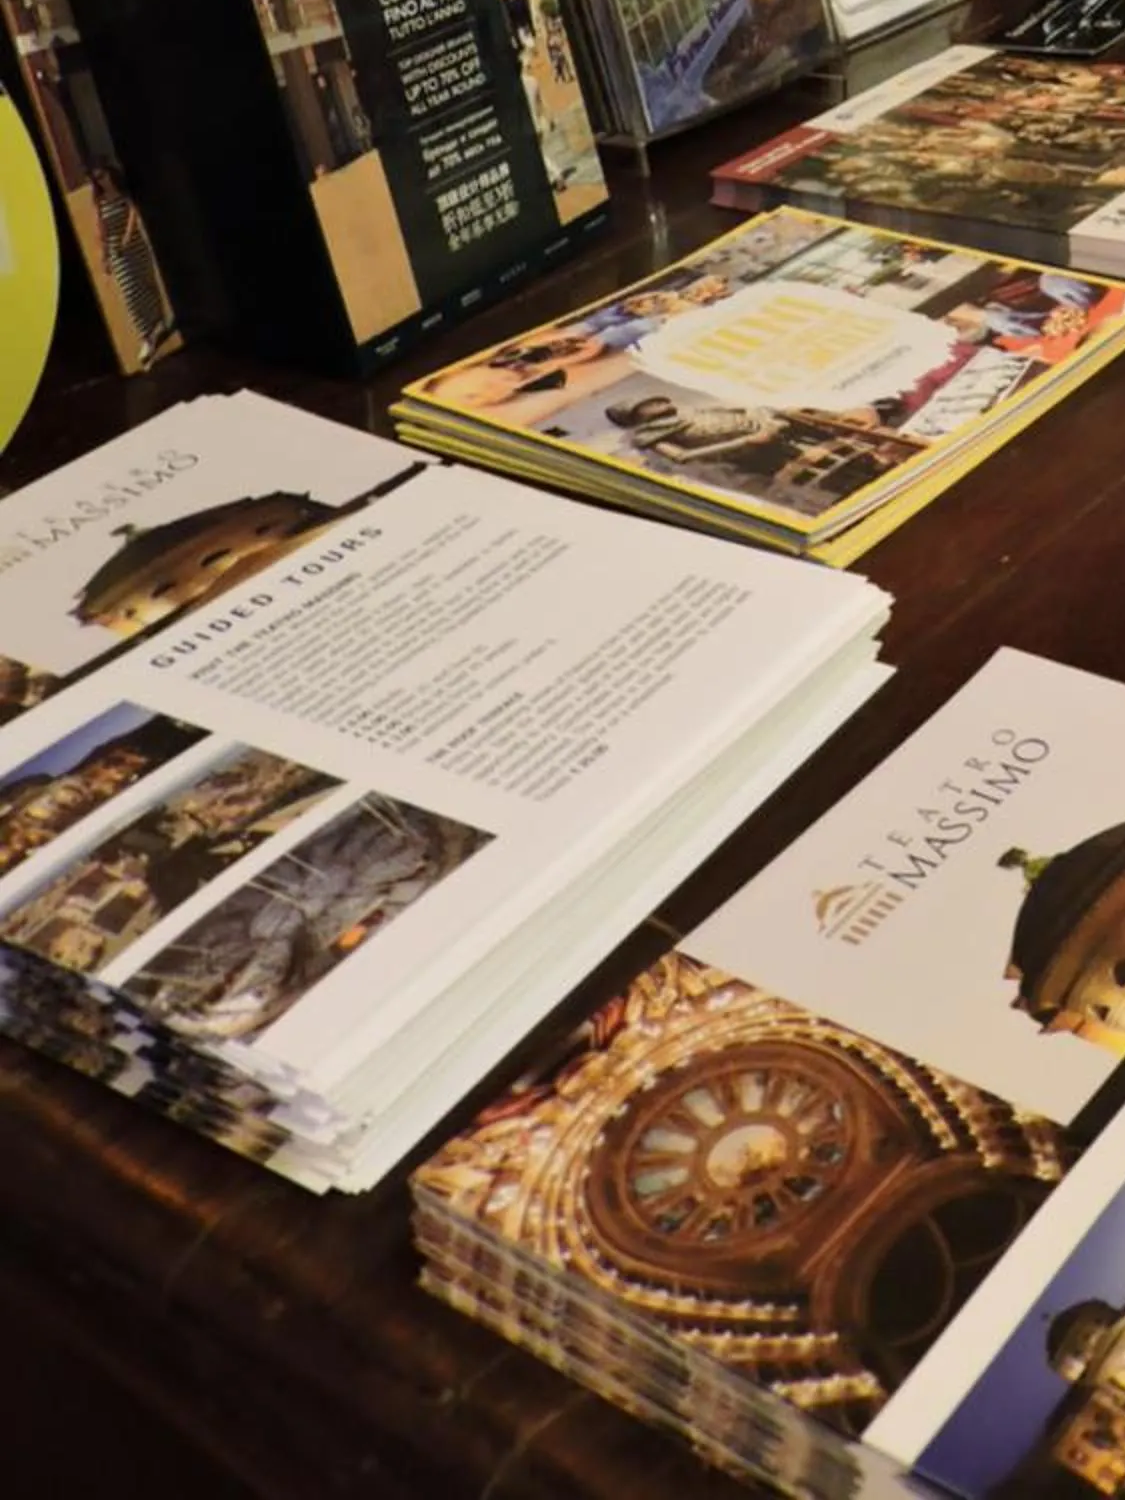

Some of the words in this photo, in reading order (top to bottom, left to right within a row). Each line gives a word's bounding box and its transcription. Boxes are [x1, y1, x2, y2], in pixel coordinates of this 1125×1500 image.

[383, 0, 419, 25] FINO
[149, 591, 275, 670] GUIDED
[280, 525, 384, 588] TOURS
[857, 727, 1017, 873] TEATRO
[887, 737, 1050, 891] MASSIMO
